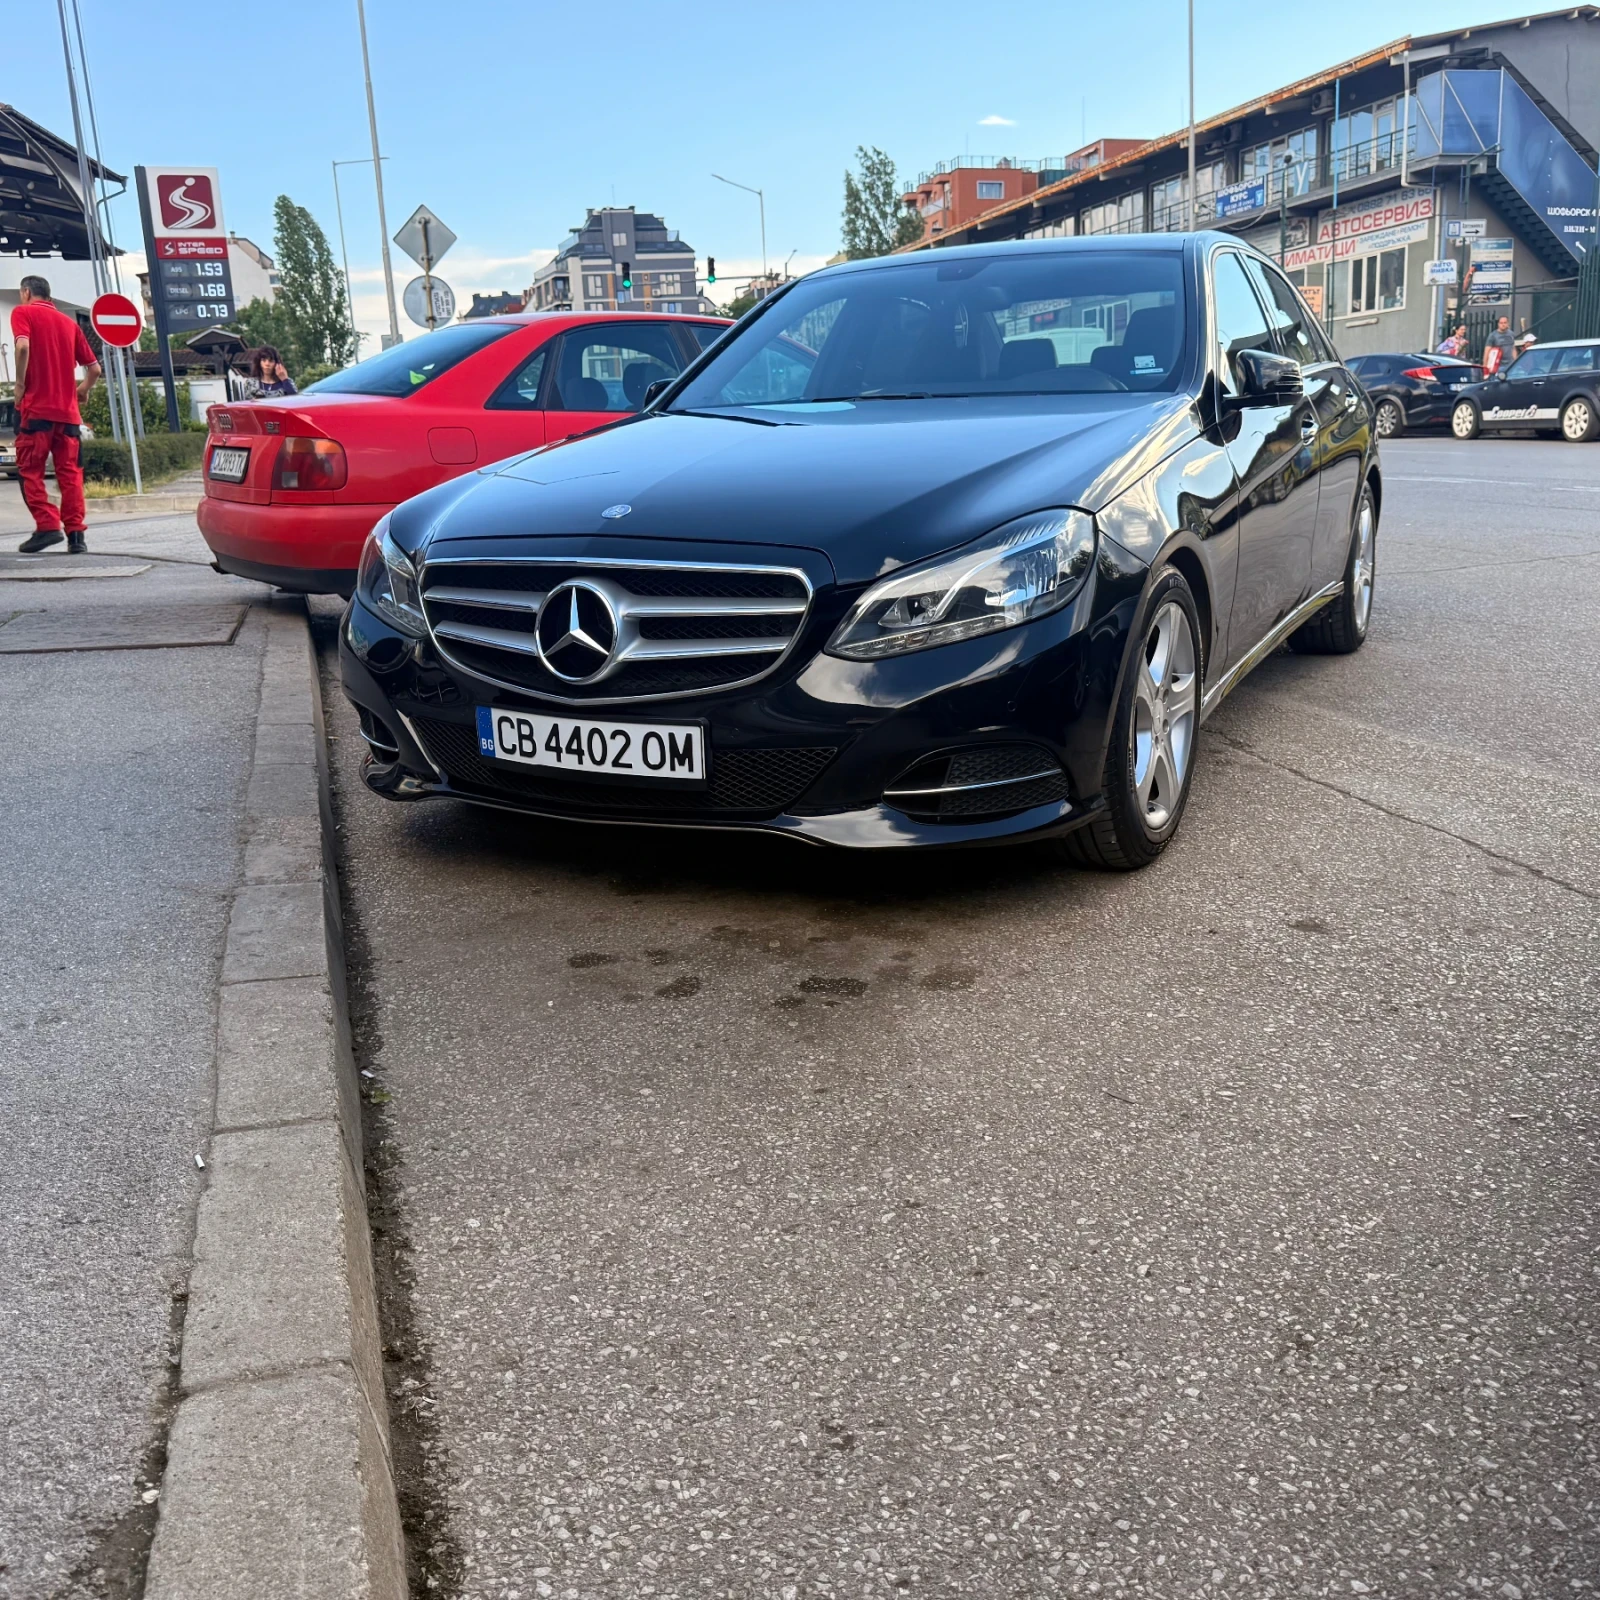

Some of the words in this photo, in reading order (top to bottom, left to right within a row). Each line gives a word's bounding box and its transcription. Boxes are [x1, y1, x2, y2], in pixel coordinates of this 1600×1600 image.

[1356, 199, 1383, 213] 0882
[1386, 193, 1399, 206] 71
[1401, 189, 1416, 201] 63
[1319, 198, 1432, 240] АВТОСЕРВИЗ
[1358, 229, 1397, 244] ЗАРЕЖДАНЕ
[1399, 222, 1426, 235] РЕМОНТ
[1372, 234, 1412, 249] ПОДДРЪЖКА
[178, 247, 223, 255] SPEED
[1274, 239, 1356, 268] ИМАТИЦИ
[195, 262, 223, 276] 1.53
[198, 283, 226, 297] 1.68
[197, 304, 229, 318] 0.73
[1492, 406, 1526, 418] Cooper
[481, 738, 494, 751] BG
[497, 716, 537, 758] CB
[544, 723, 633, 769] 4402
[641, 731, 694, 773] OM
